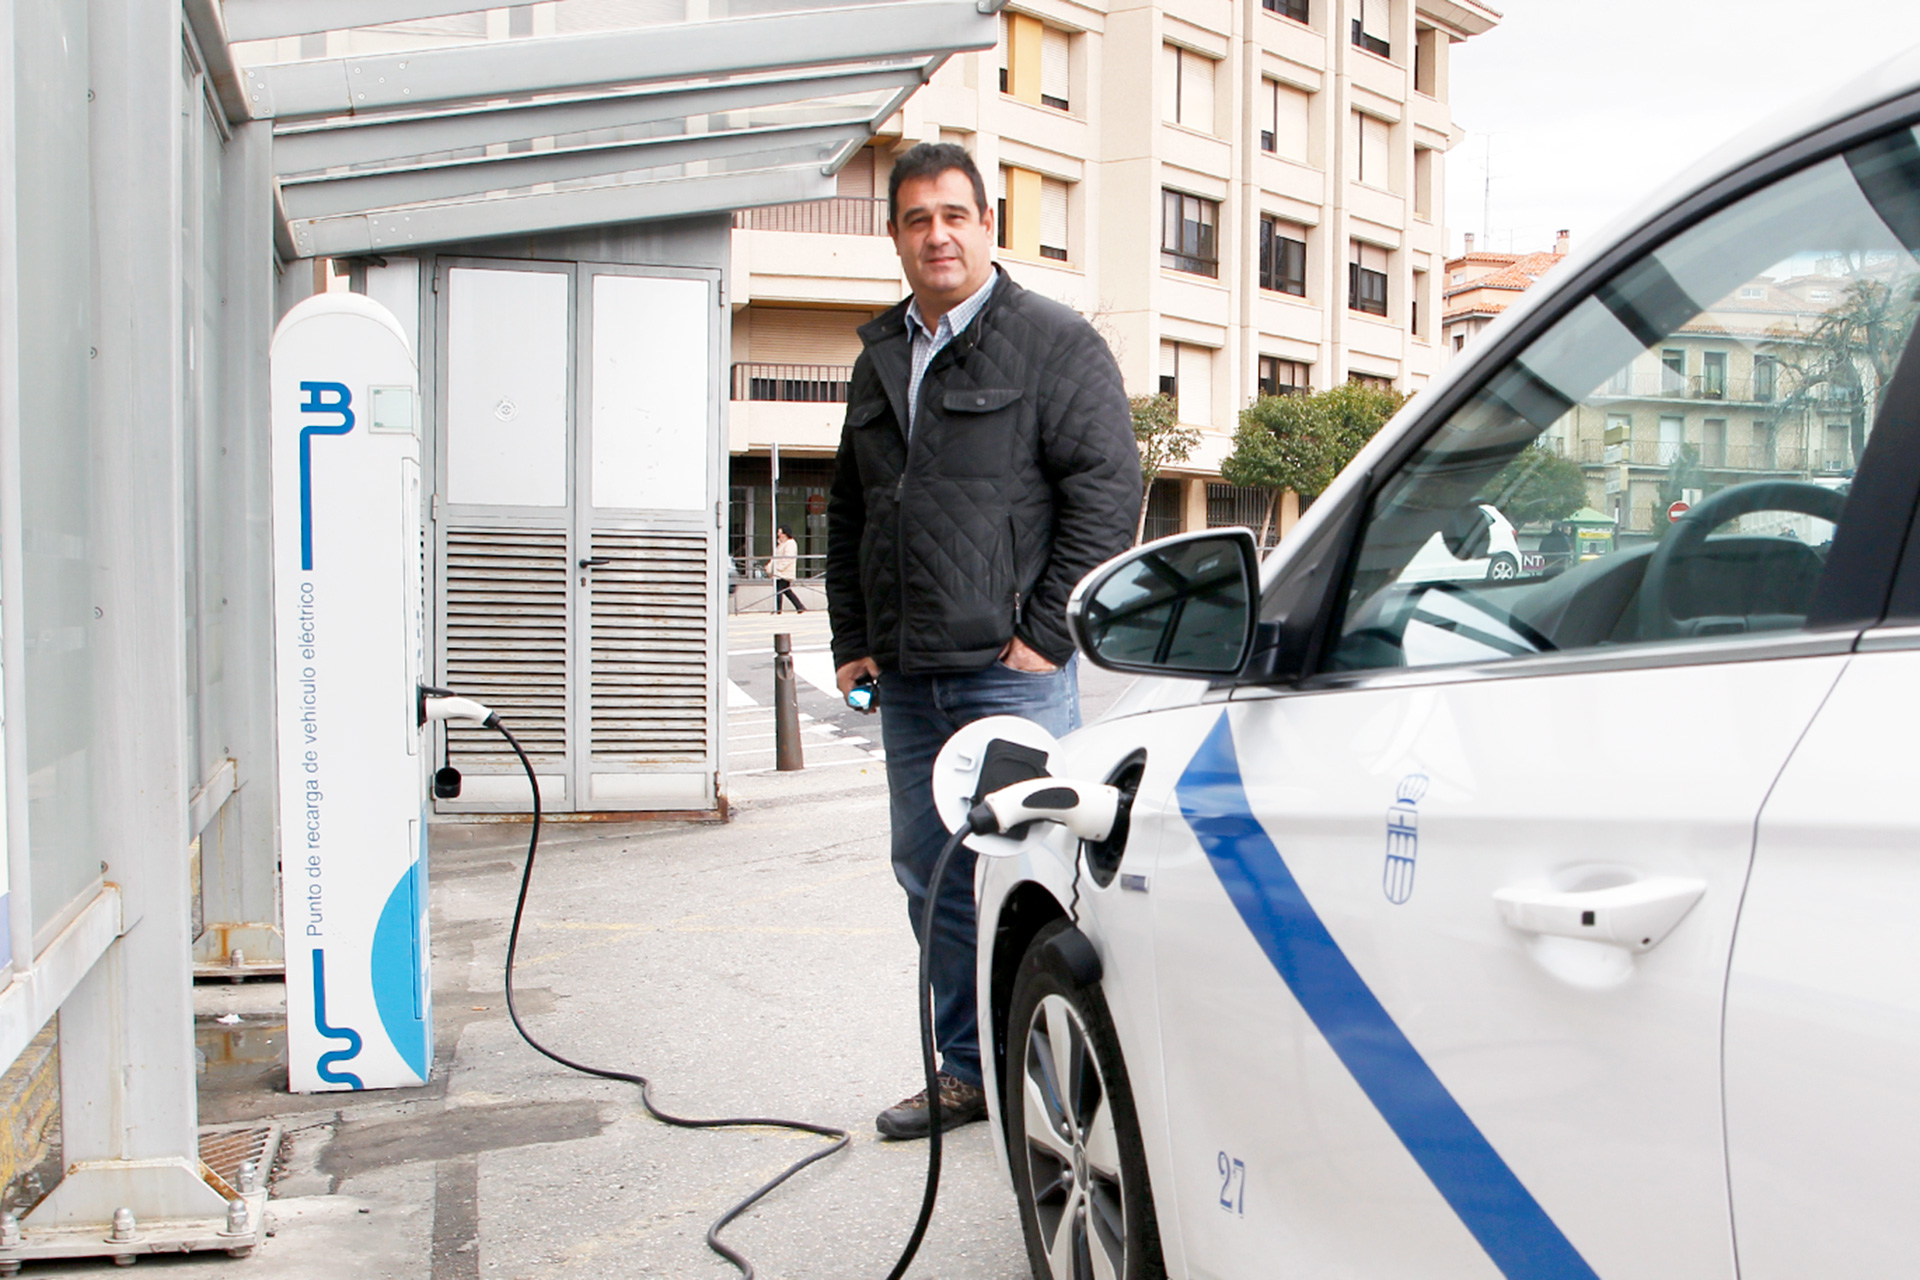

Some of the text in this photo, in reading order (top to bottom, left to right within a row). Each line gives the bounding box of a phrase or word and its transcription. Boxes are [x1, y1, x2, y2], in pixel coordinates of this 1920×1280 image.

[297, 582, 323, 936] Punto de recarga de vehículo eléctrico
[1218, 1150, 1244, 1217] 27
